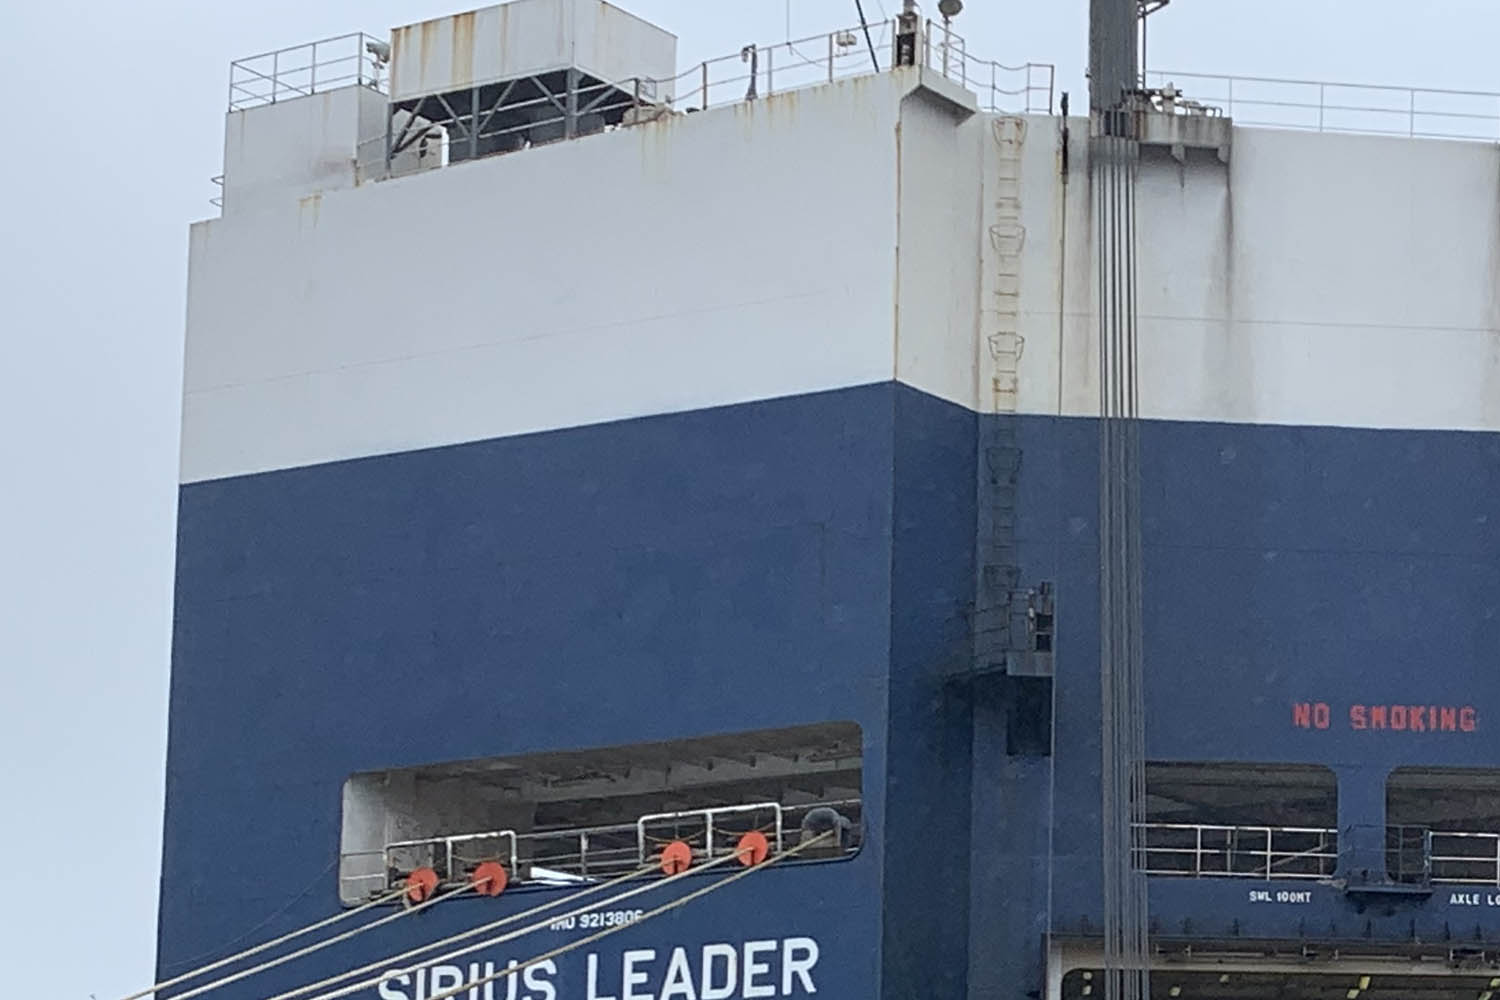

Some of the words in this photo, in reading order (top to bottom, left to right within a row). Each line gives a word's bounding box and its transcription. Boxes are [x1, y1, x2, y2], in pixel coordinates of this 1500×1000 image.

[1293, 702, 1330, 729] NO
[1351, 704, 1476, 732] SMOKING
[1249, 890, 1273, 902] SWL
[1276, 891, 1312, 903] 100MT
[1450, 893, 1480, 905] AXLE
